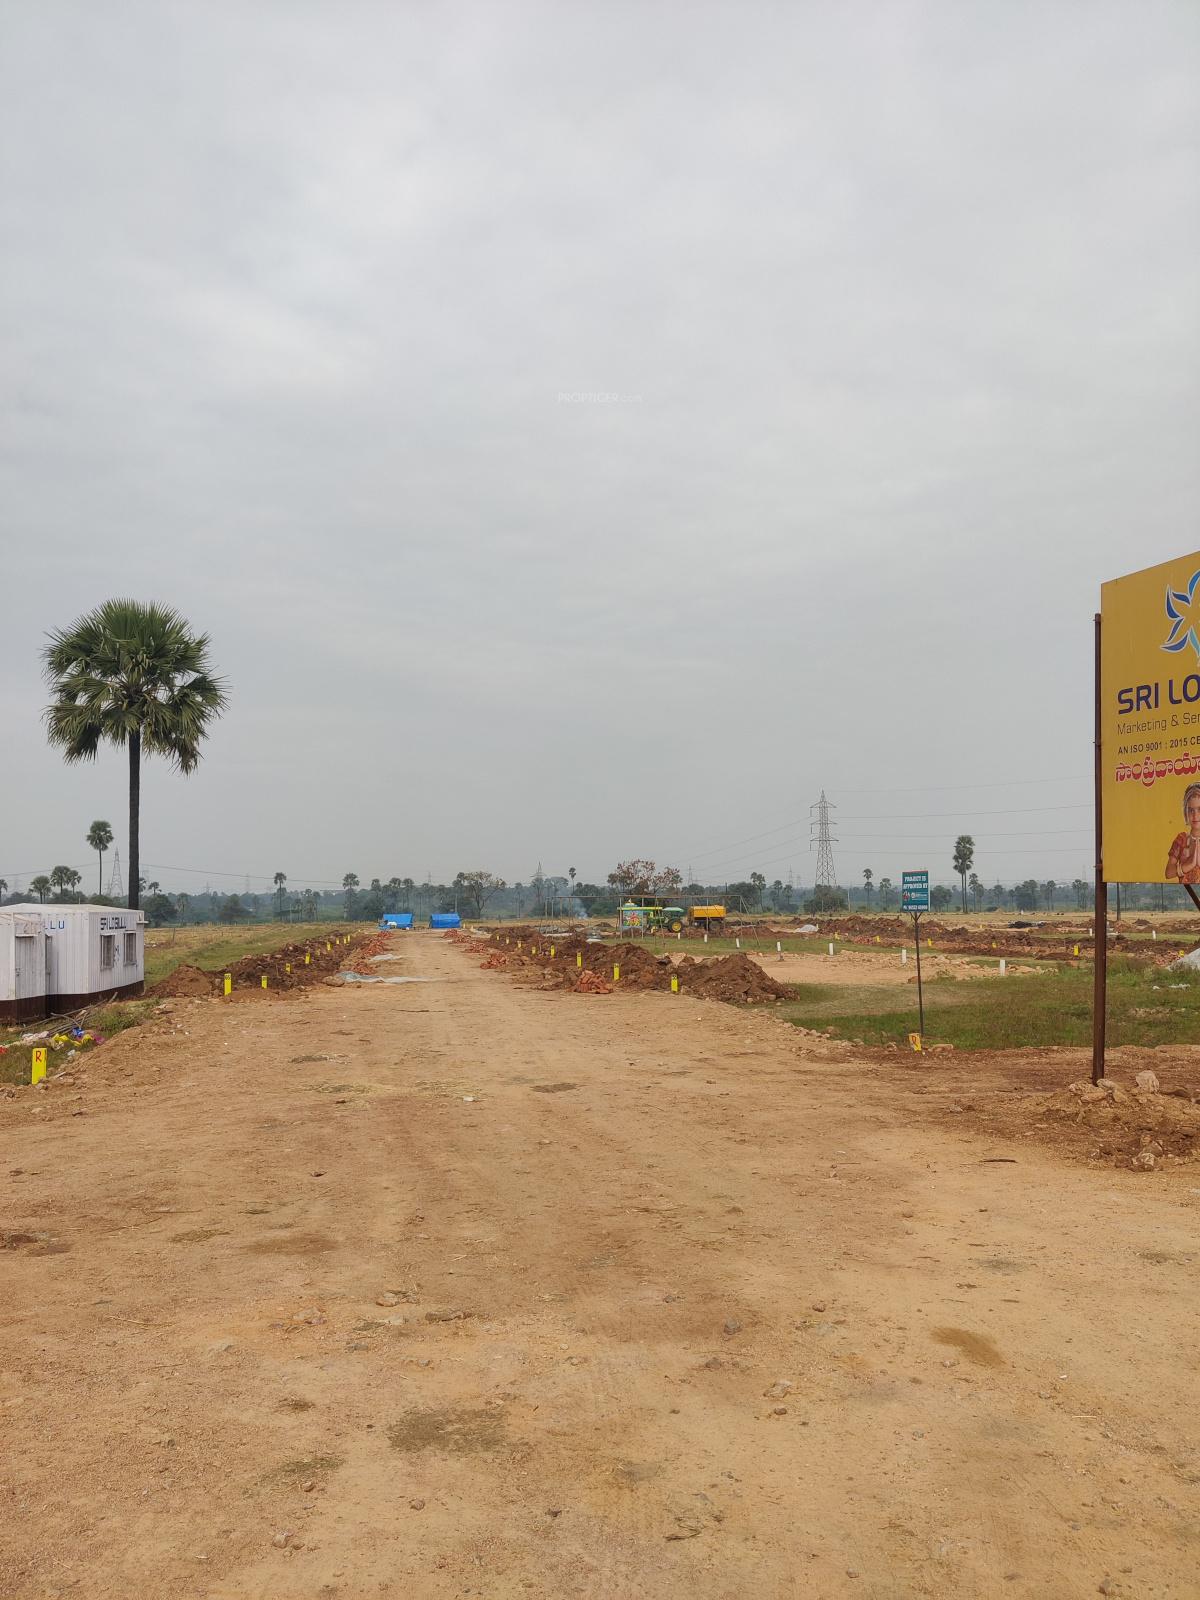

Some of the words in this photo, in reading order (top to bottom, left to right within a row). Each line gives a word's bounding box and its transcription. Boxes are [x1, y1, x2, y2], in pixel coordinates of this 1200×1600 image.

[1117, 682, 1159, 715] SRI
[1168, 674, 1200, 705] LO
[1117, 718, 1167, 736] Marketing
[1171, 714, 1180, 727] &
[1118, 746, 1129, 755] AN
[1130, 744, 1144, 754] ISO
[1145, 742, 1162, 751] 9001
[1169, 737, 1188, 748] 2015
[36, 1051, 42, 1062] R
